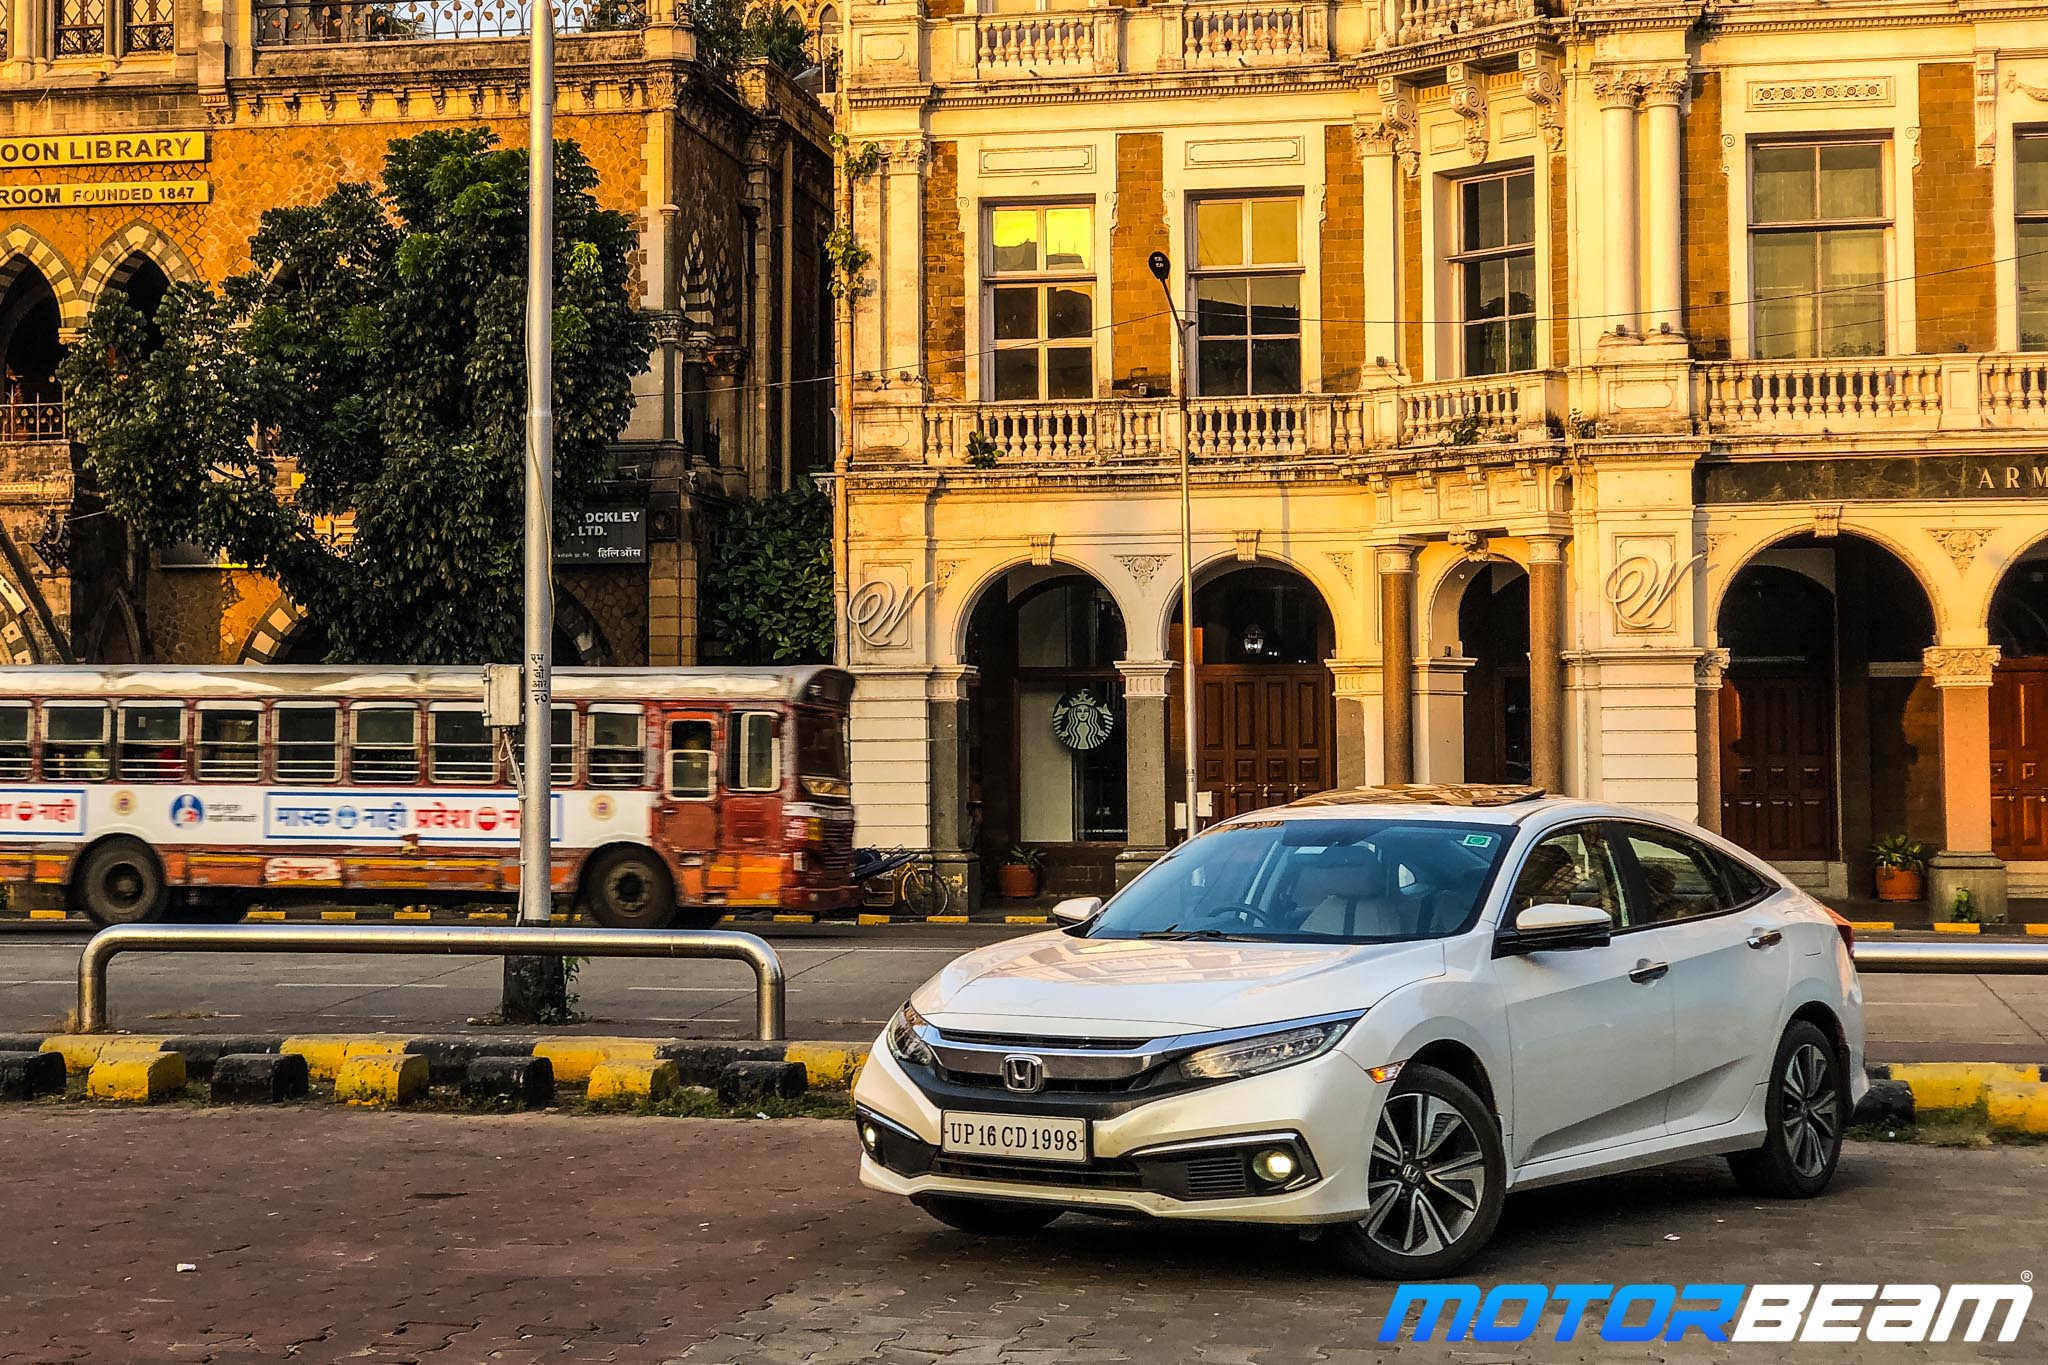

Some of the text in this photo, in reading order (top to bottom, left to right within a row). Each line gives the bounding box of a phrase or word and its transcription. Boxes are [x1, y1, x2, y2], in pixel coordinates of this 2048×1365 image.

[70, 137, 192, 159] LIBRARY
[0, 187, 195, 205] ROOM FOUNDED 1847
[579, 511, 640, 523] OCKLEY
[578, 525, 608, 537] LTD.
